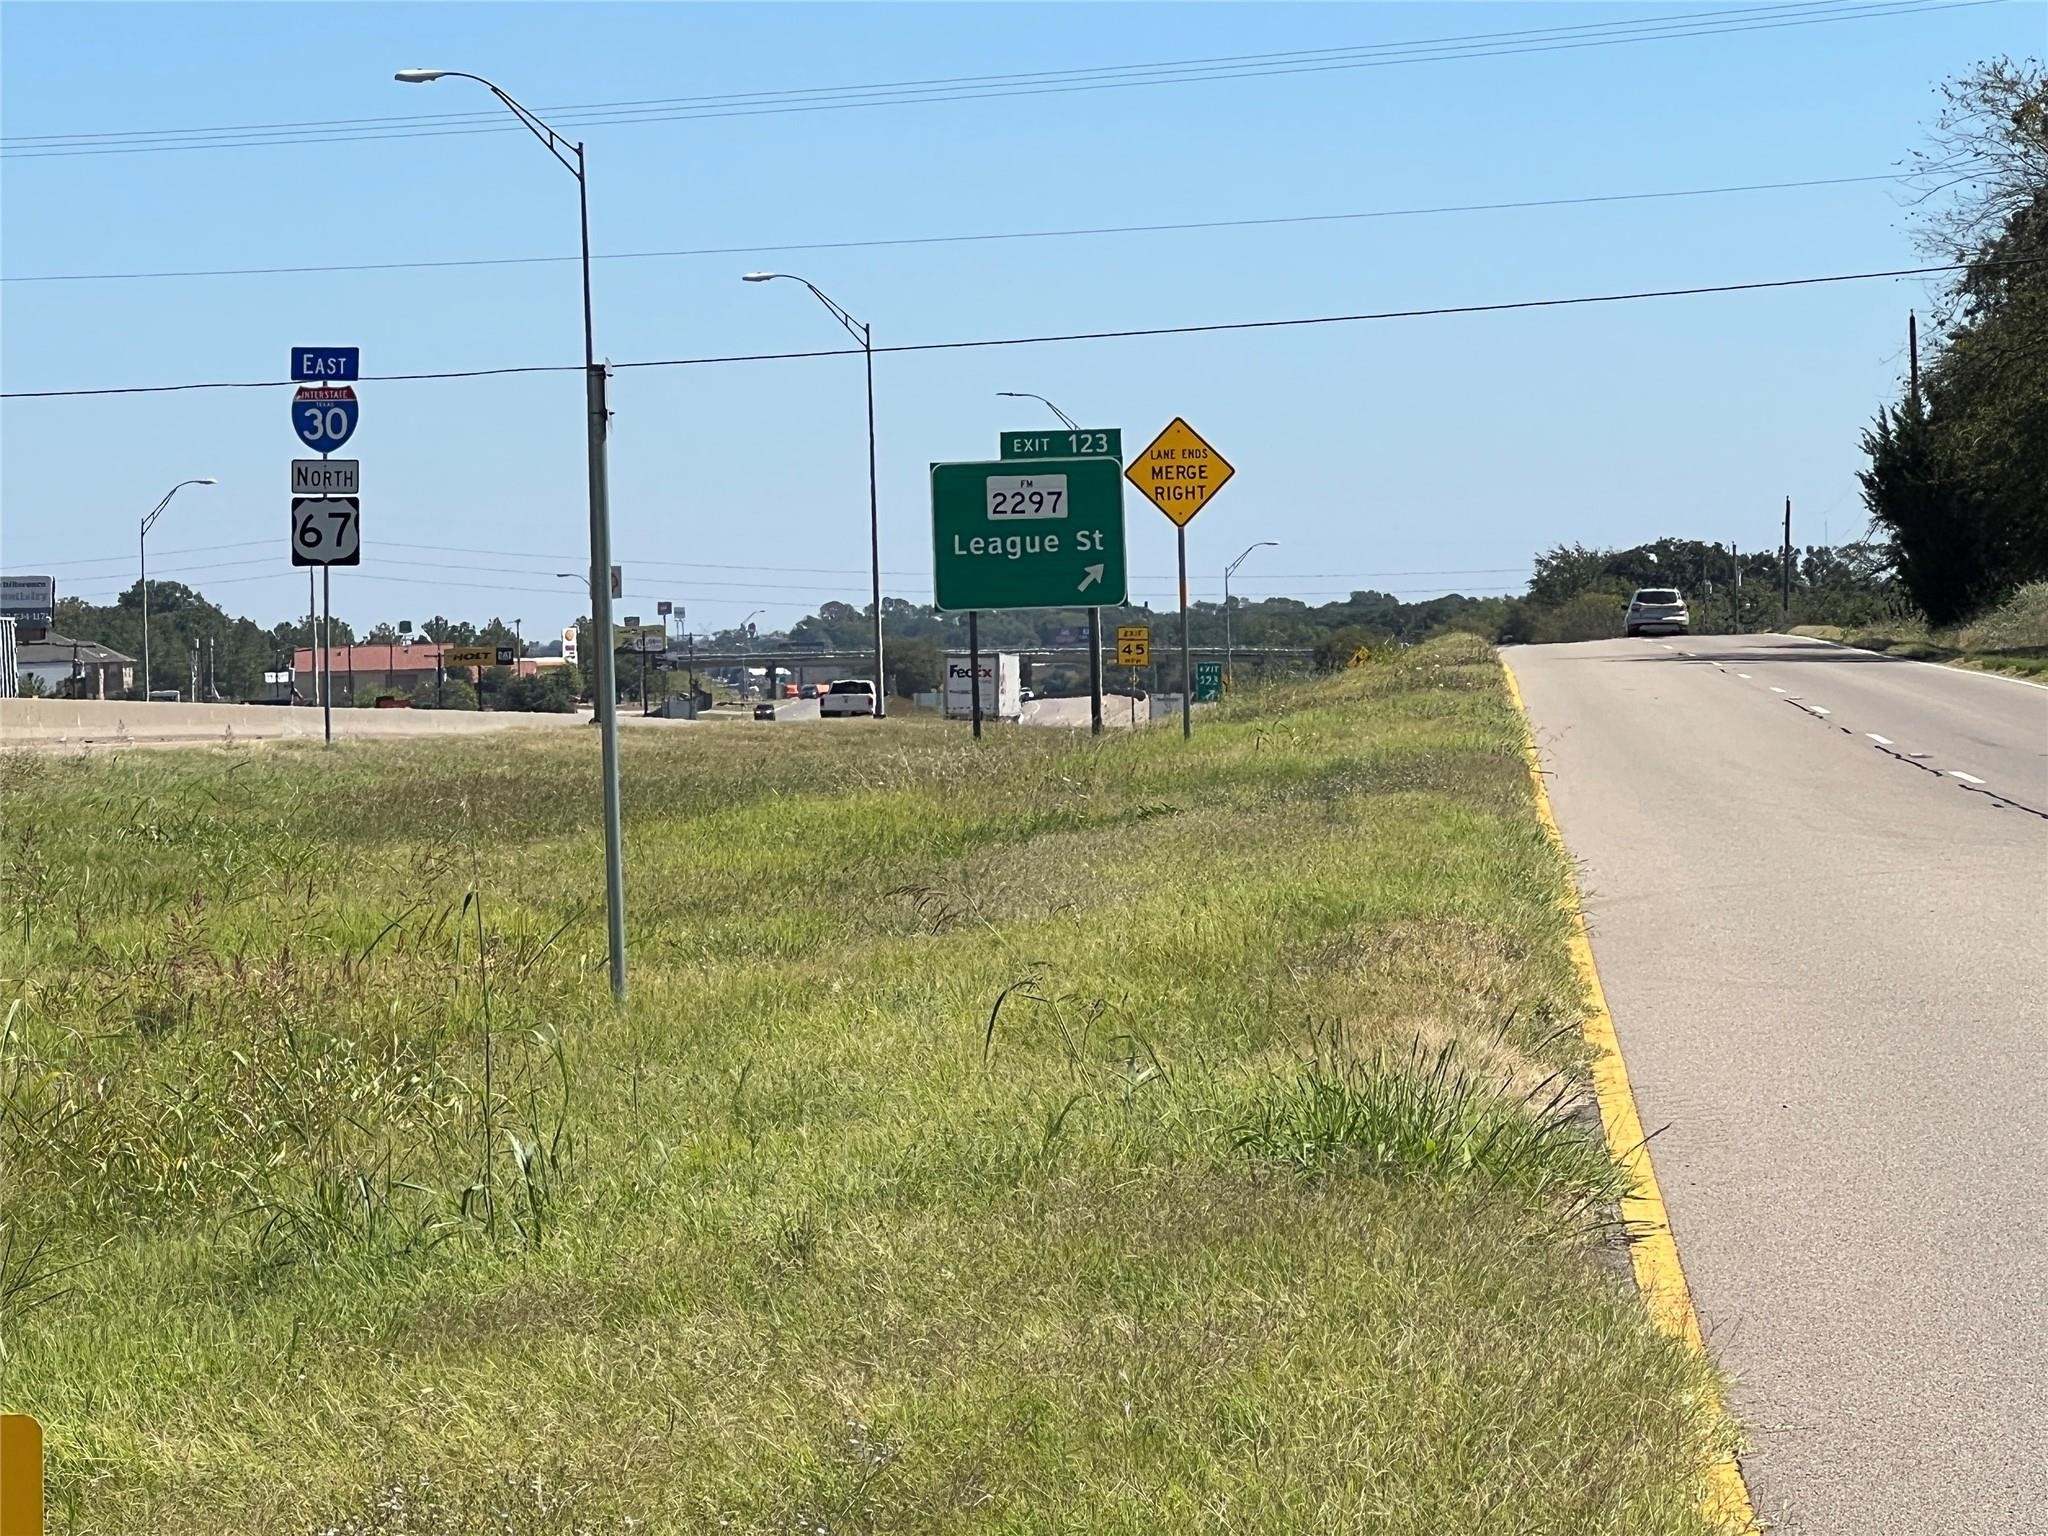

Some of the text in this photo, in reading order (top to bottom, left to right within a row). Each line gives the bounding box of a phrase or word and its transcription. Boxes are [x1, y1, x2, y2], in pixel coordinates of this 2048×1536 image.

[303, 354, 346, 374] EAST
[301, 390, 348, 399] INTERSTATE
[303, 408, 348, 440] 30
[1013, 433, 1108, 453] EXIT 123
[1150, 448, 1208, 460] LANE ENDS
[297, 467, 354, 487] NORTH
[1151, 465, 1208, 480] MERGE
[1020, 480, 1033, 488] FM
[1154, 485, 1207, 501] RIGHT
[992, 491, 1063, 515] 2297
[299, 513, 352, 548] 67
[954, 530, 1104, 560] League St
[453, 650, 513, 661] HOLT CAT
[1122, 643, 1145, 655] 45
[949, 664, 992, 678] FedEx
[1199, 665, 1220, 673] EXIT
